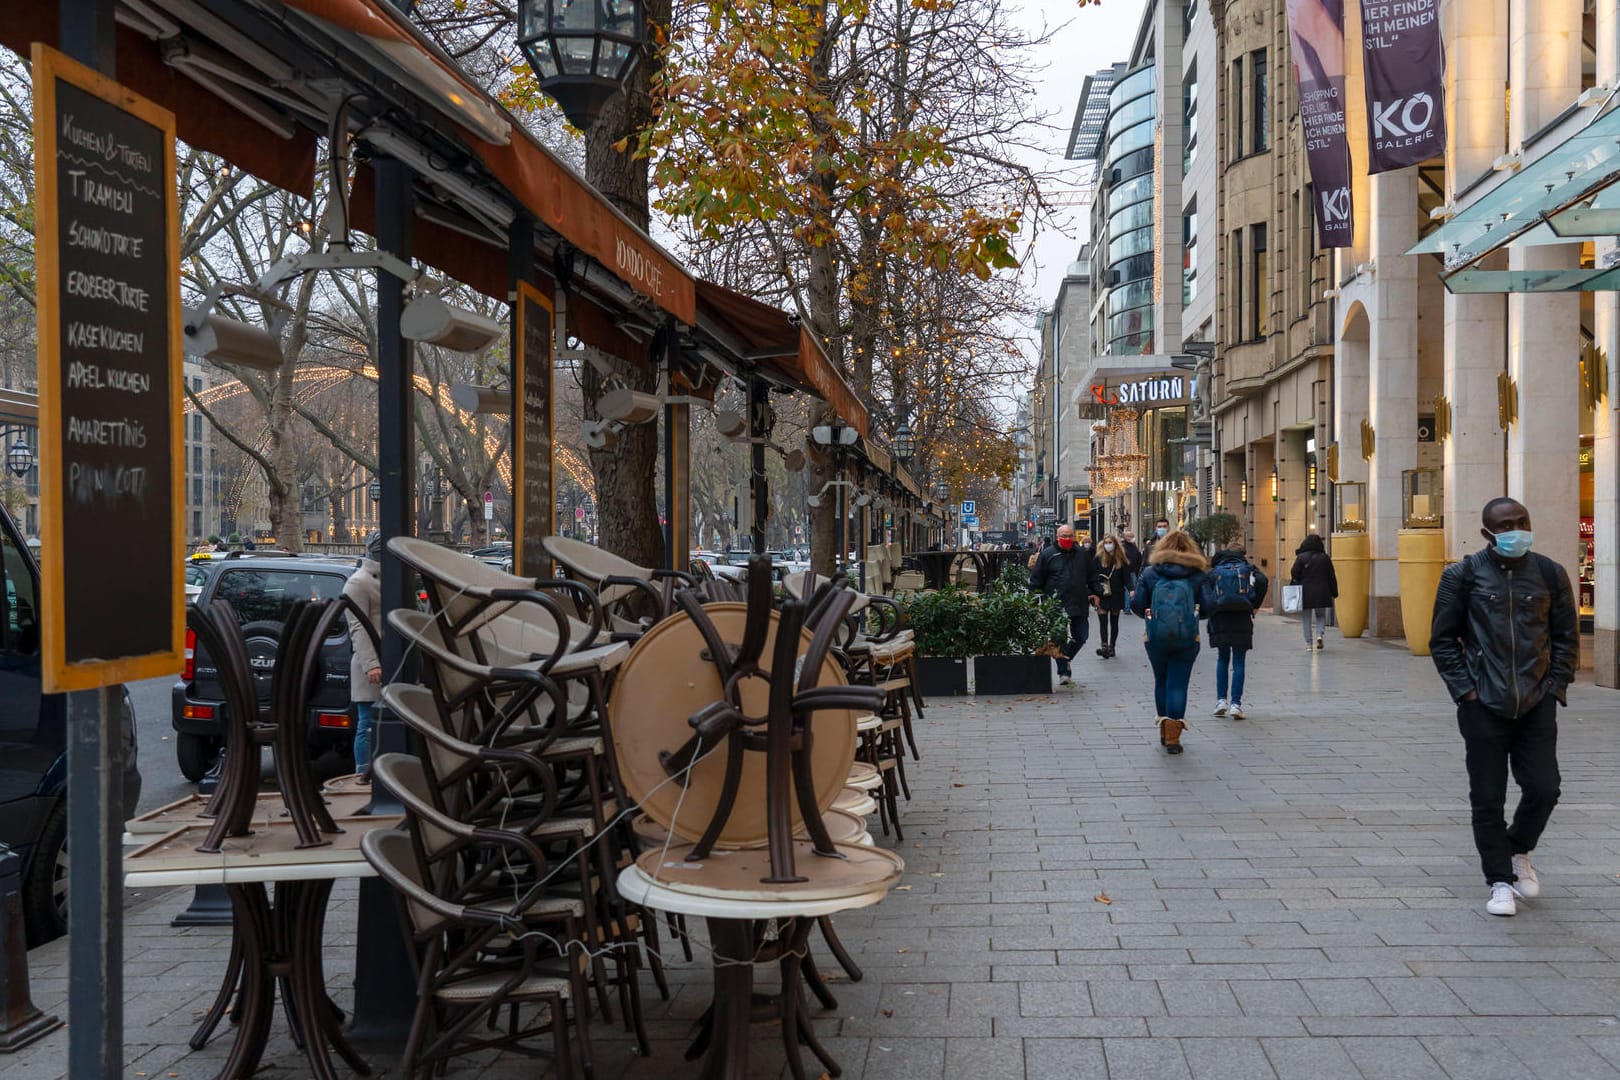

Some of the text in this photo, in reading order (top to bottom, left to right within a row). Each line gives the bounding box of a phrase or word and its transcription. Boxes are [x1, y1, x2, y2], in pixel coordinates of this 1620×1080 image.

[1384, 9, 1435, 33] MEINEN
[63, 113, 105, 153] KUCHEN
[1306, 127, 1321, 139] ICH
[1376, 129, 1434, 150] GALERIE
[67, 170, 133, 214] TIRAMISU
[107, 368, 150, 393] KUCHEN
[1120, 377, 1183, 403] SATURN
